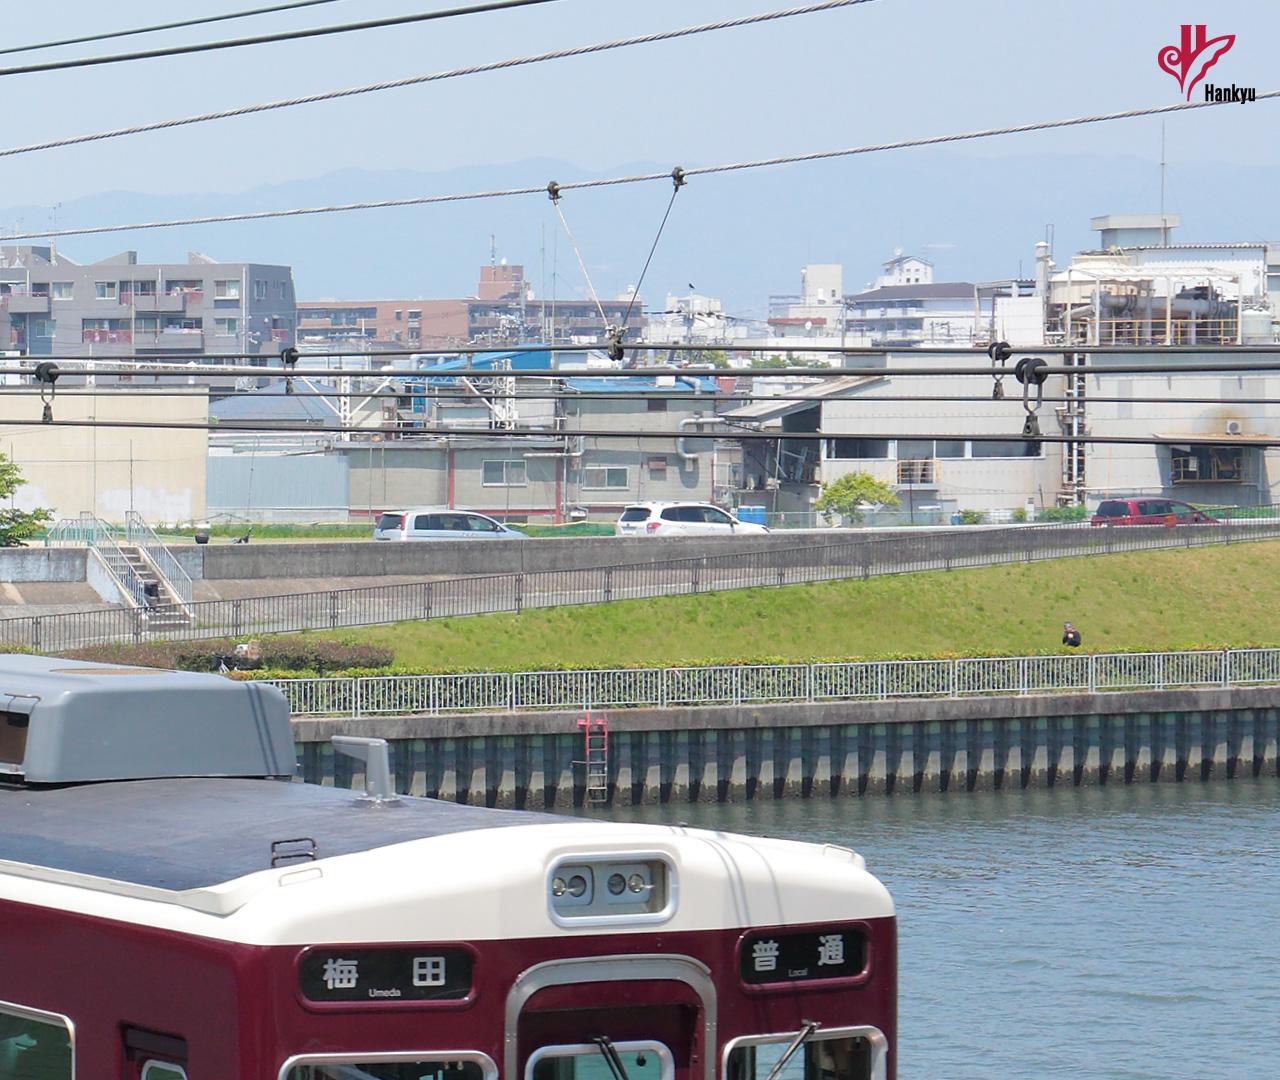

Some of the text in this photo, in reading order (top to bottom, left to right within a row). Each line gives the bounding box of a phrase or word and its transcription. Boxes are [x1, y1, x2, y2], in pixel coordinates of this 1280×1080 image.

[752, 934, 845, 971] 普通
[323, 957, 446, 990] 梅田
[788, 967, 809, 977] Local
[369, 988, 401, 997] Umeda
